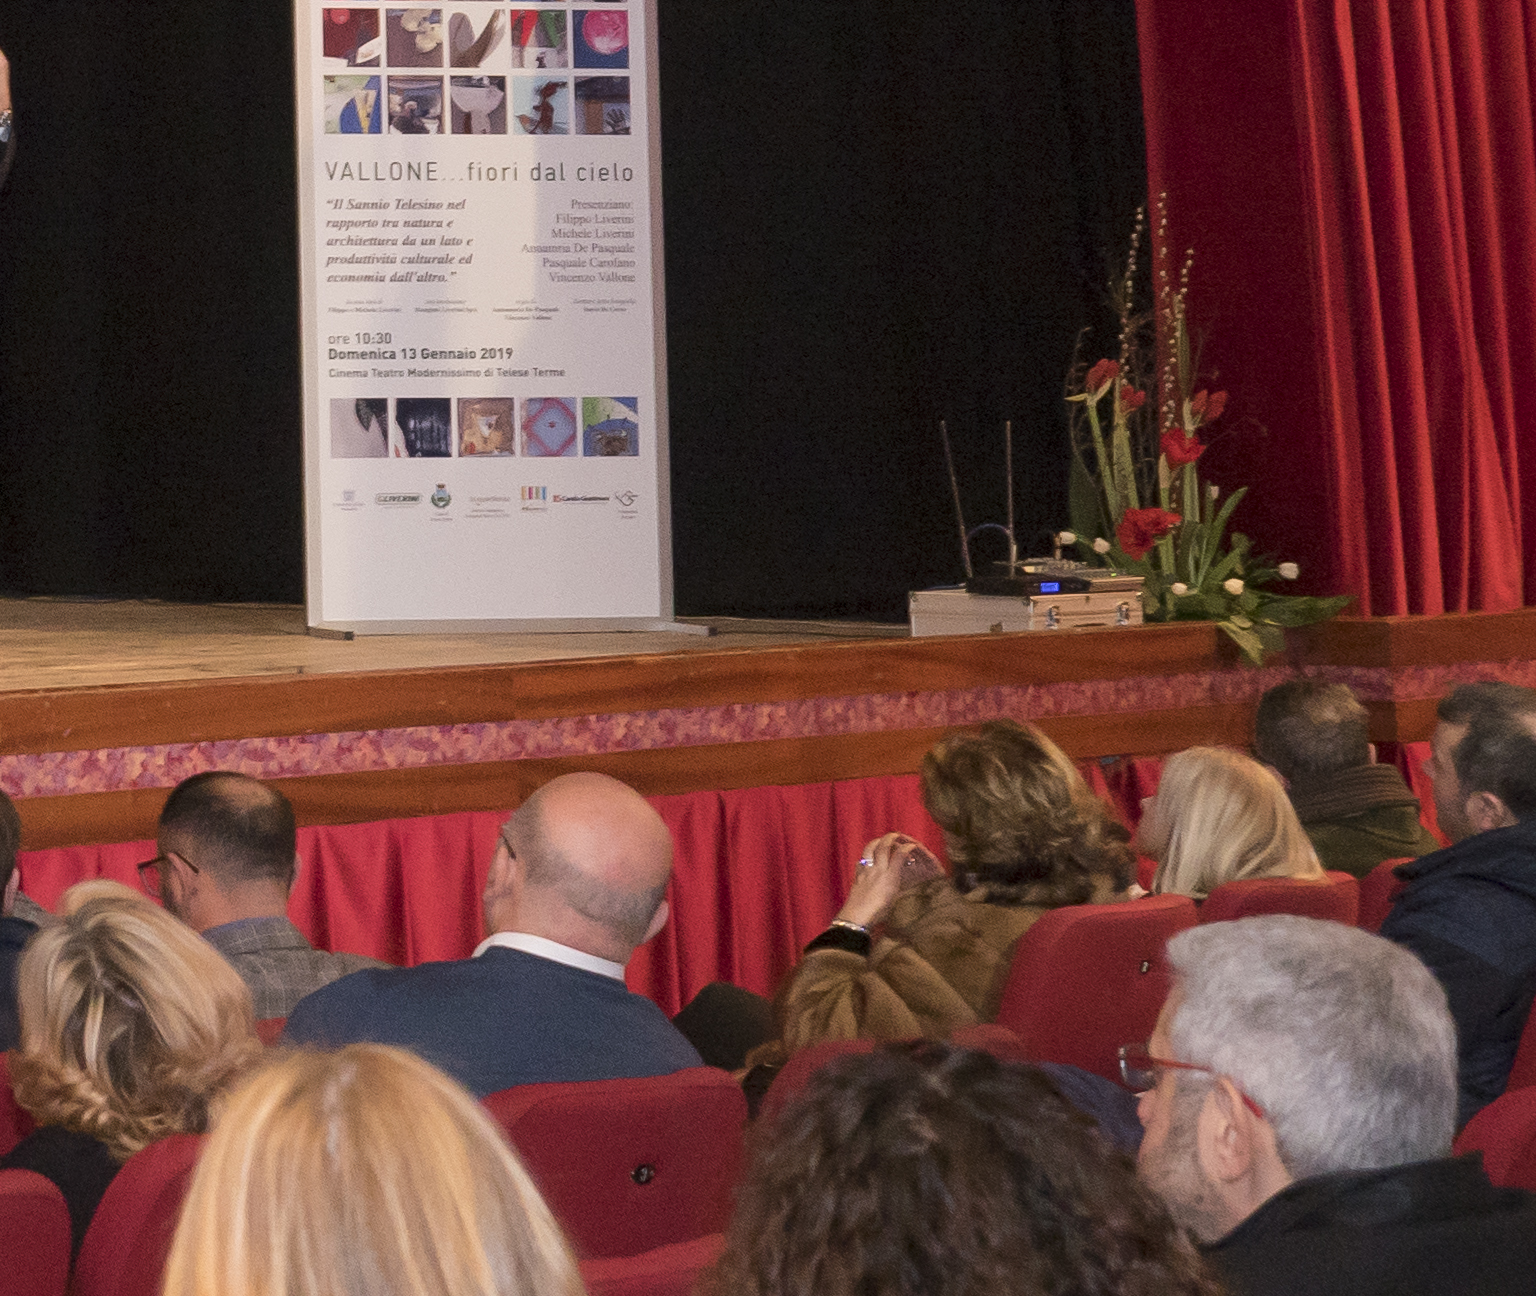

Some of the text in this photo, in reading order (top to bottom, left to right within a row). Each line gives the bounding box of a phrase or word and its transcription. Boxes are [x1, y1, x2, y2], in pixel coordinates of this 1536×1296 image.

[530, 162, 565, 182] dal
[577, 162, 634, 182] cielo
[346, 199, 390, 210] Sannio
[395, 198, 443, 210] Telesino
[446, 199, 466, 210] nel
[326, 219, 454, 231] rapporto tra natura e
[555, 213, 592, 226] Filippo
[326, 236, 473, 246] architettura da un lato e
[591, 243, 635, 255] Pasquale
[400, 253, 455, 264] culturale
[458, 253, 473, 264] ed
[542, 258, 586, 270] Pasquale
[326, 273, 386, 283] economia
[549, 272, 636, 283] Vincenzo Vallone
[328, 333, 392, 344] ore 10:30
[328, 348, 513, 360] Domenica 13 Gennaio 2019
[329, 369, 368, 378] Cinema
[372, 368, 404, 377] Teatro
[407, 368, 481, 377] Modernissimo
[484, 368, 494, 377] di
[532, 368, 565, 377] Terme
